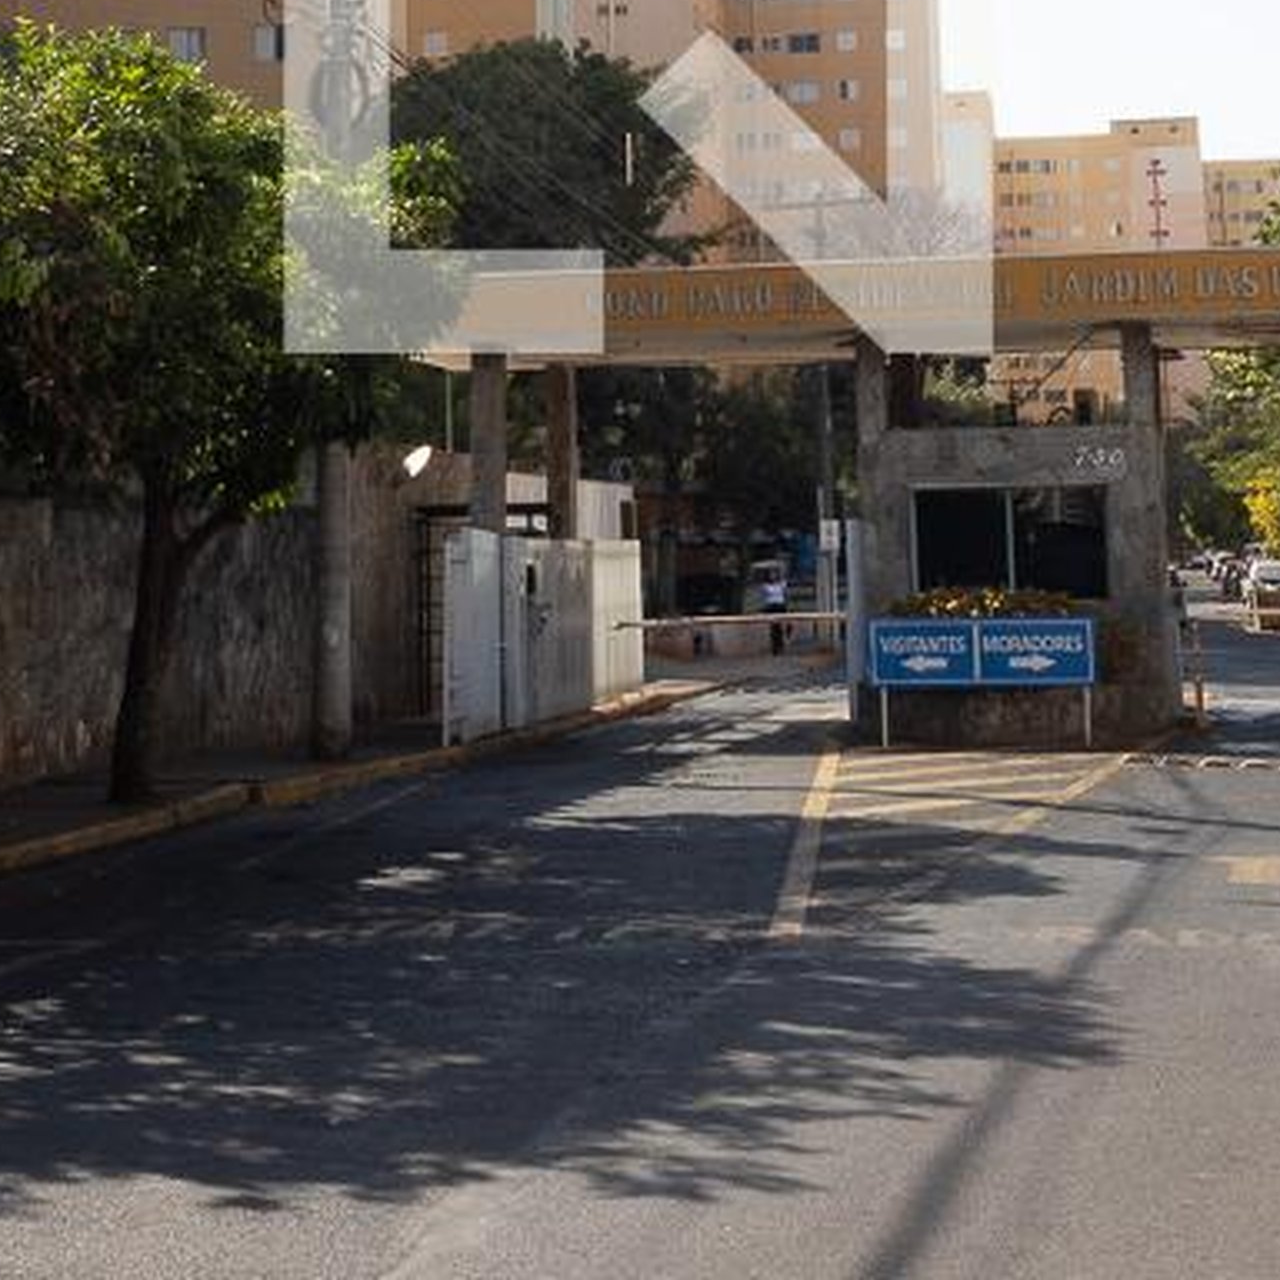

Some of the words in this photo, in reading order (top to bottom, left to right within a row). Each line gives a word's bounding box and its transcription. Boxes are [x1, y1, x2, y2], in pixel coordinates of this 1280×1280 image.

[1042, 266, 1179, 305] JARDIM
[1196, 265, 1259, 299] DAS
[879, 635, 966, 654] VISITANTES
[982, 634, 1084, 653] MORADORES
